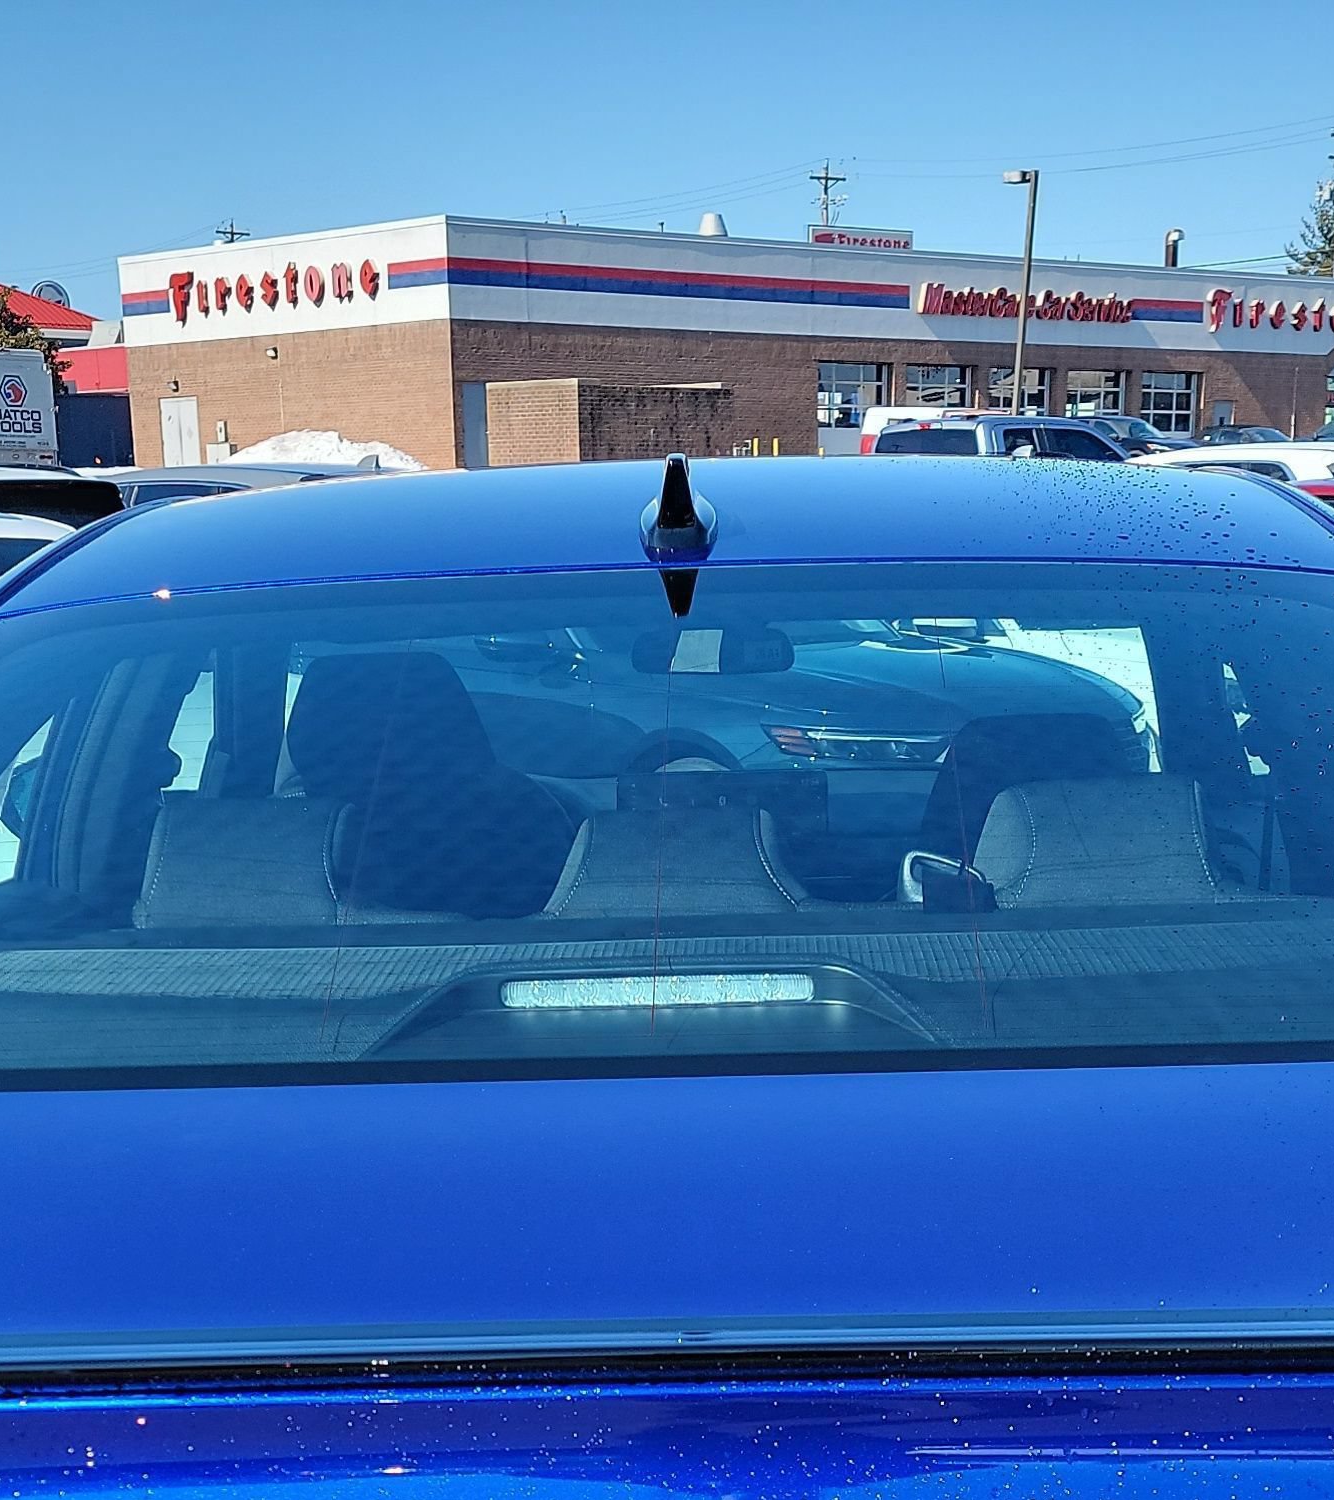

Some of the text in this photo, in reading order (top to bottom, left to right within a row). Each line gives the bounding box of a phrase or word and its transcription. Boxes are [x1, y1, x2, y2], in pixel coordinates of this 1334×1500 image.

[834, 232, 911, 249] Firestone
[169, 258, 380, 326] Firestone
[1037, 289, 1068, 321] Car
[1067, 290, 1133, 324] Service
